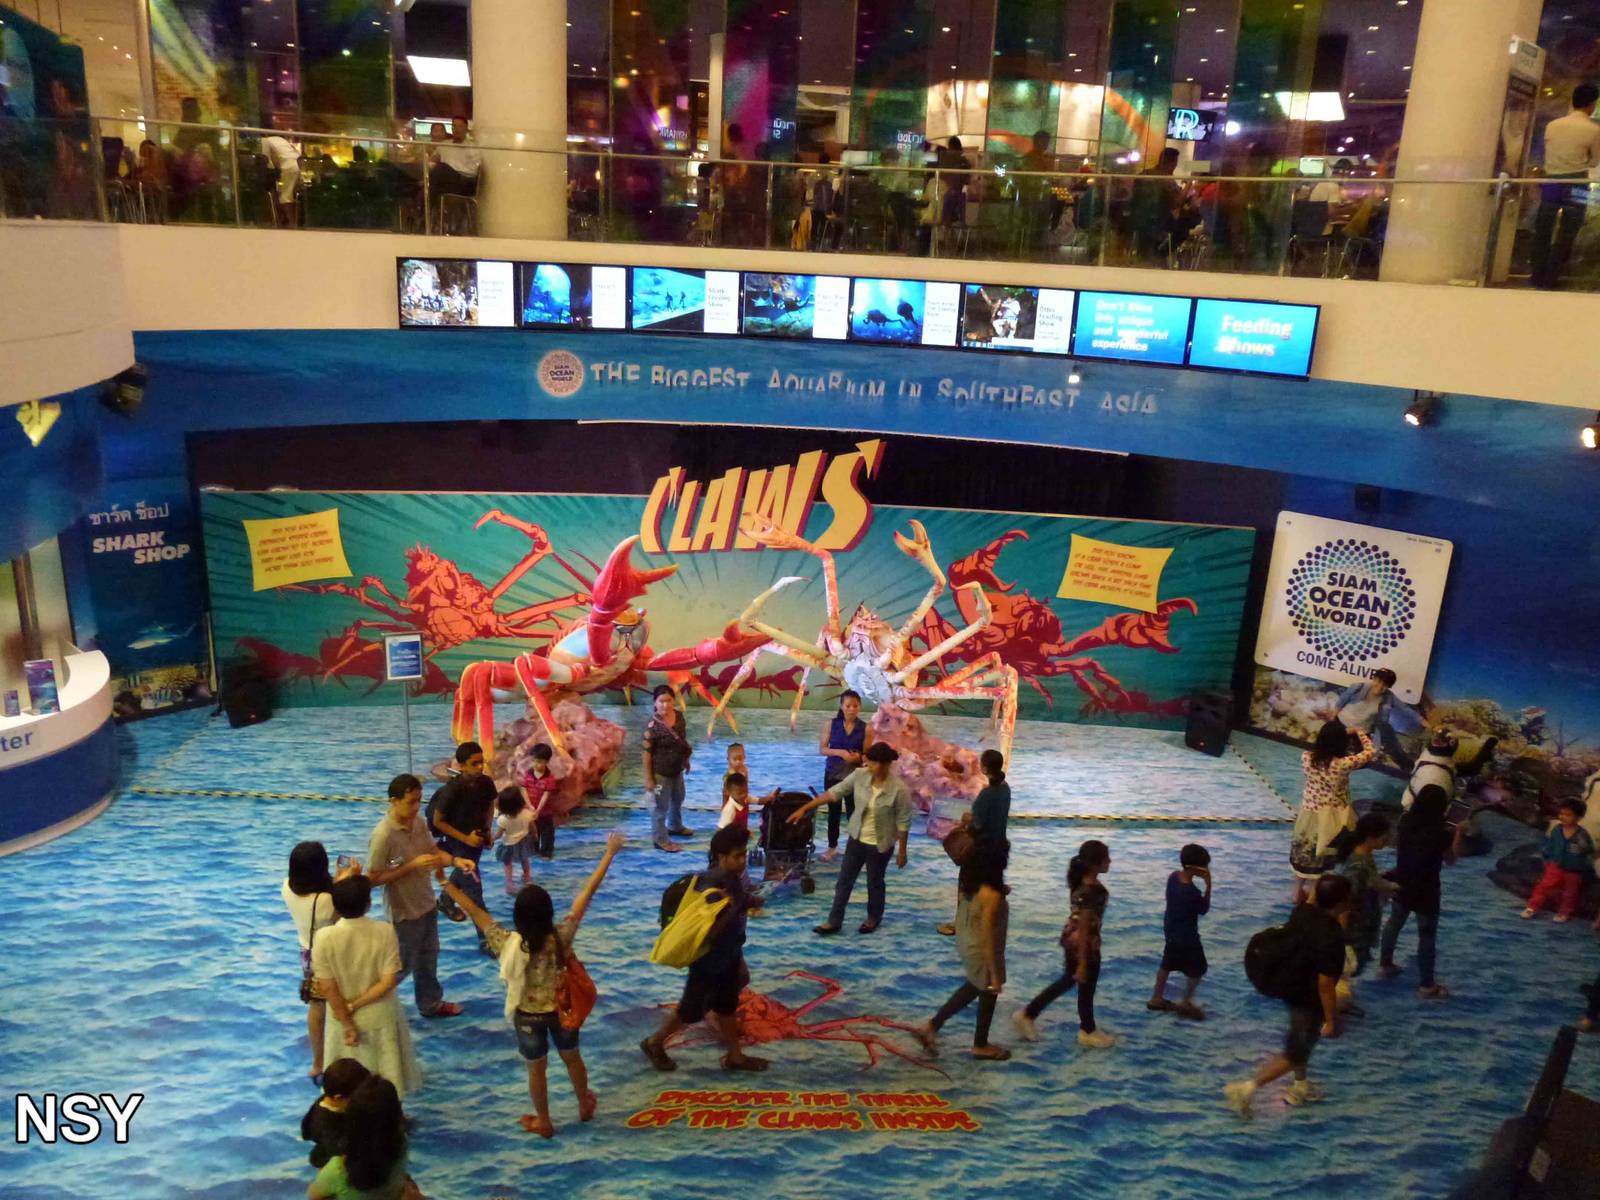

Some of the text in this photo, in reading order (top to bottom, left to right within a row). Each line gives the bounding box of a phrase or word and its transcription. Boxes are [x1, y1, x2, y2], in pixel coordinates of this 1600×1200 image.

[1221, 314, 1294, 340] Feeding
[590, 361, 641, 382] THE
[651, 365, 751, 388] BIGGEST
[898, 380, 922, 398] IN
[1101, 391, 1158, 414] ASIA
[639, 438, 887, 554] CLAWS
[92, 531, 165, 553] SHARK
[134, 544, 191, 564] SHOP
[1327, 571, 1378, 594] SIAM
[1309, 586, 1391, 617] OCEAN
[1312, 604, 1382, 631] WORLD
[1296, 650, 1337, 671] COME
[798, 1092, 850, 1107] THE
[625, 1106, 983, 1132] OF THE CLAWS INSIDE
